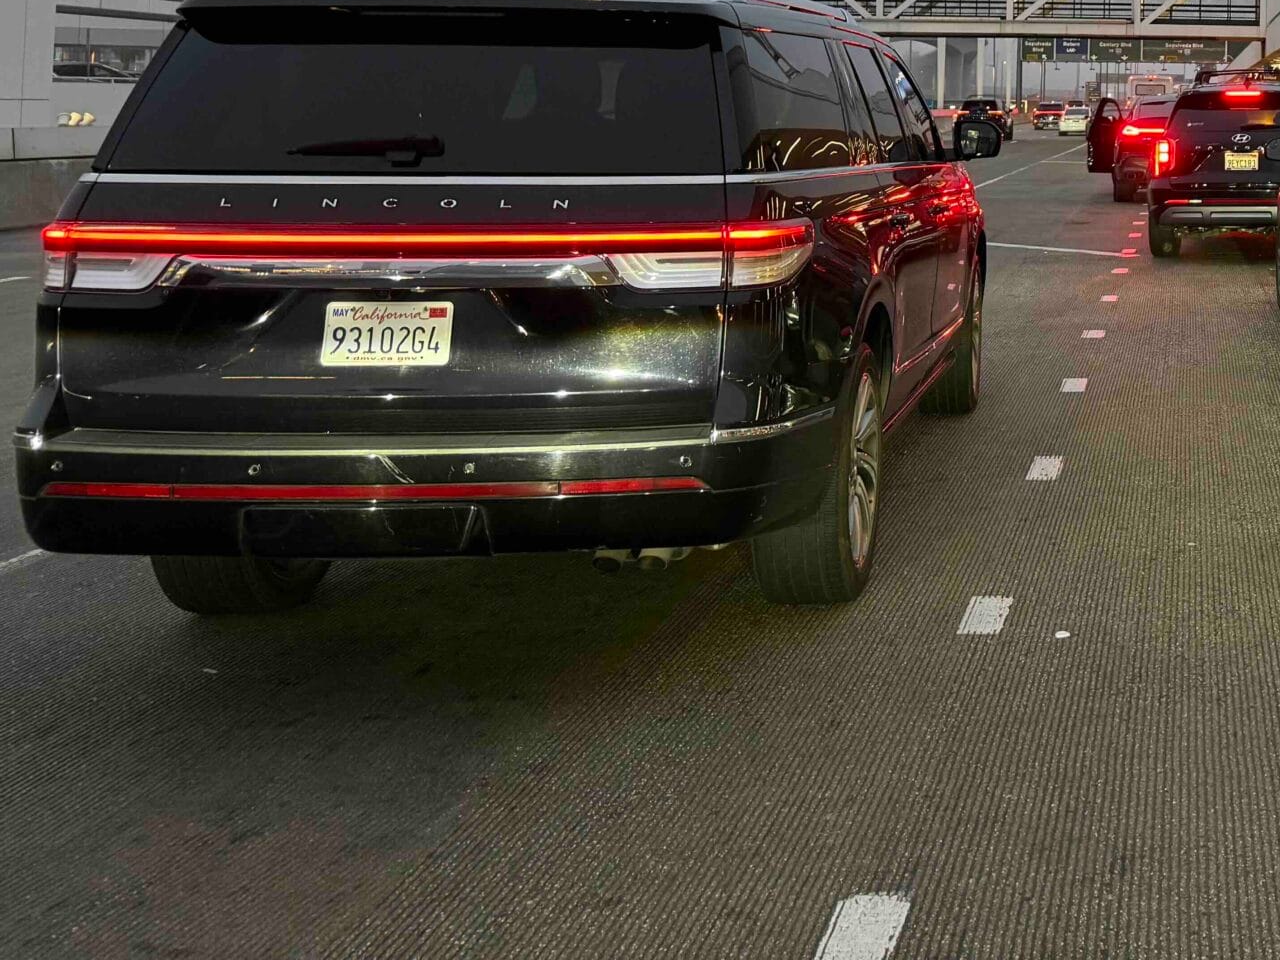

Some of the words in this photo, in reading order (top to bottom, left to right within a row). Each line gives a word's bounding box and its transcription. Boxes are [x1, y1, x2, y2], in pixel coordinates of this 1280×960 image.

[219, 197, 570, 210] LINCOLN
[332, 308, 349, 317] MAY
[352, 306, 425, 325] California
[329, 326, 440, 355] 93102G4
